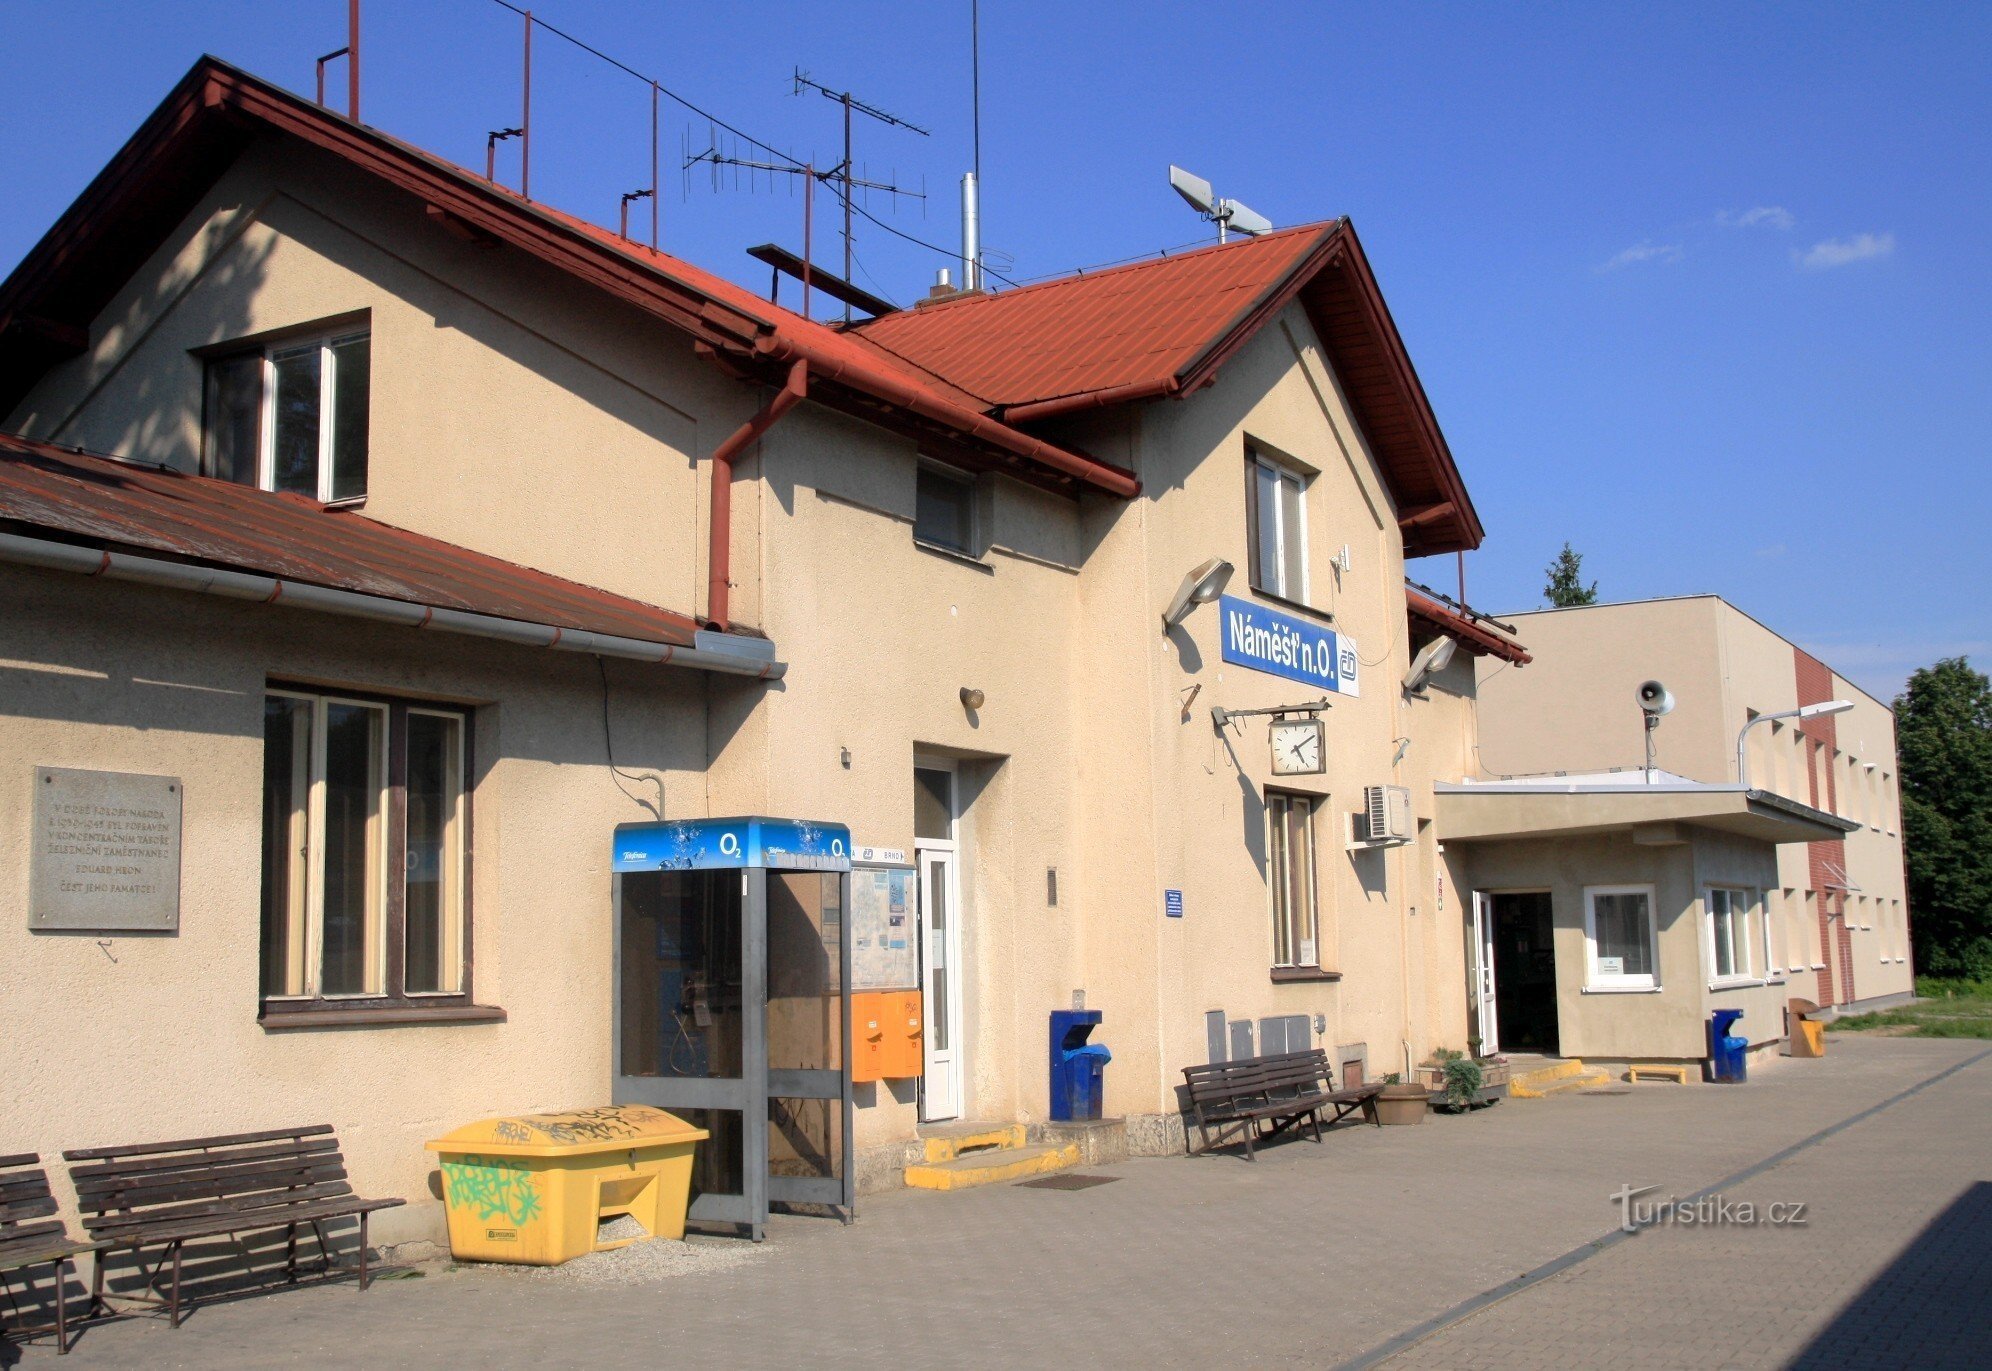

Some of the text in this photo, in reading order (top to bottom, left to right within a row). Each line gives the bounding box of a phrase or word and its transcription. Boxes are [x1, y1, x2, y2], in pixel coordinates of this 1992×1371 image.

[1229, 610, 1300, 669] Náměšť
[76, 865, 112, 874] EDUARD
[86, 883, 108, 894] JEHO
